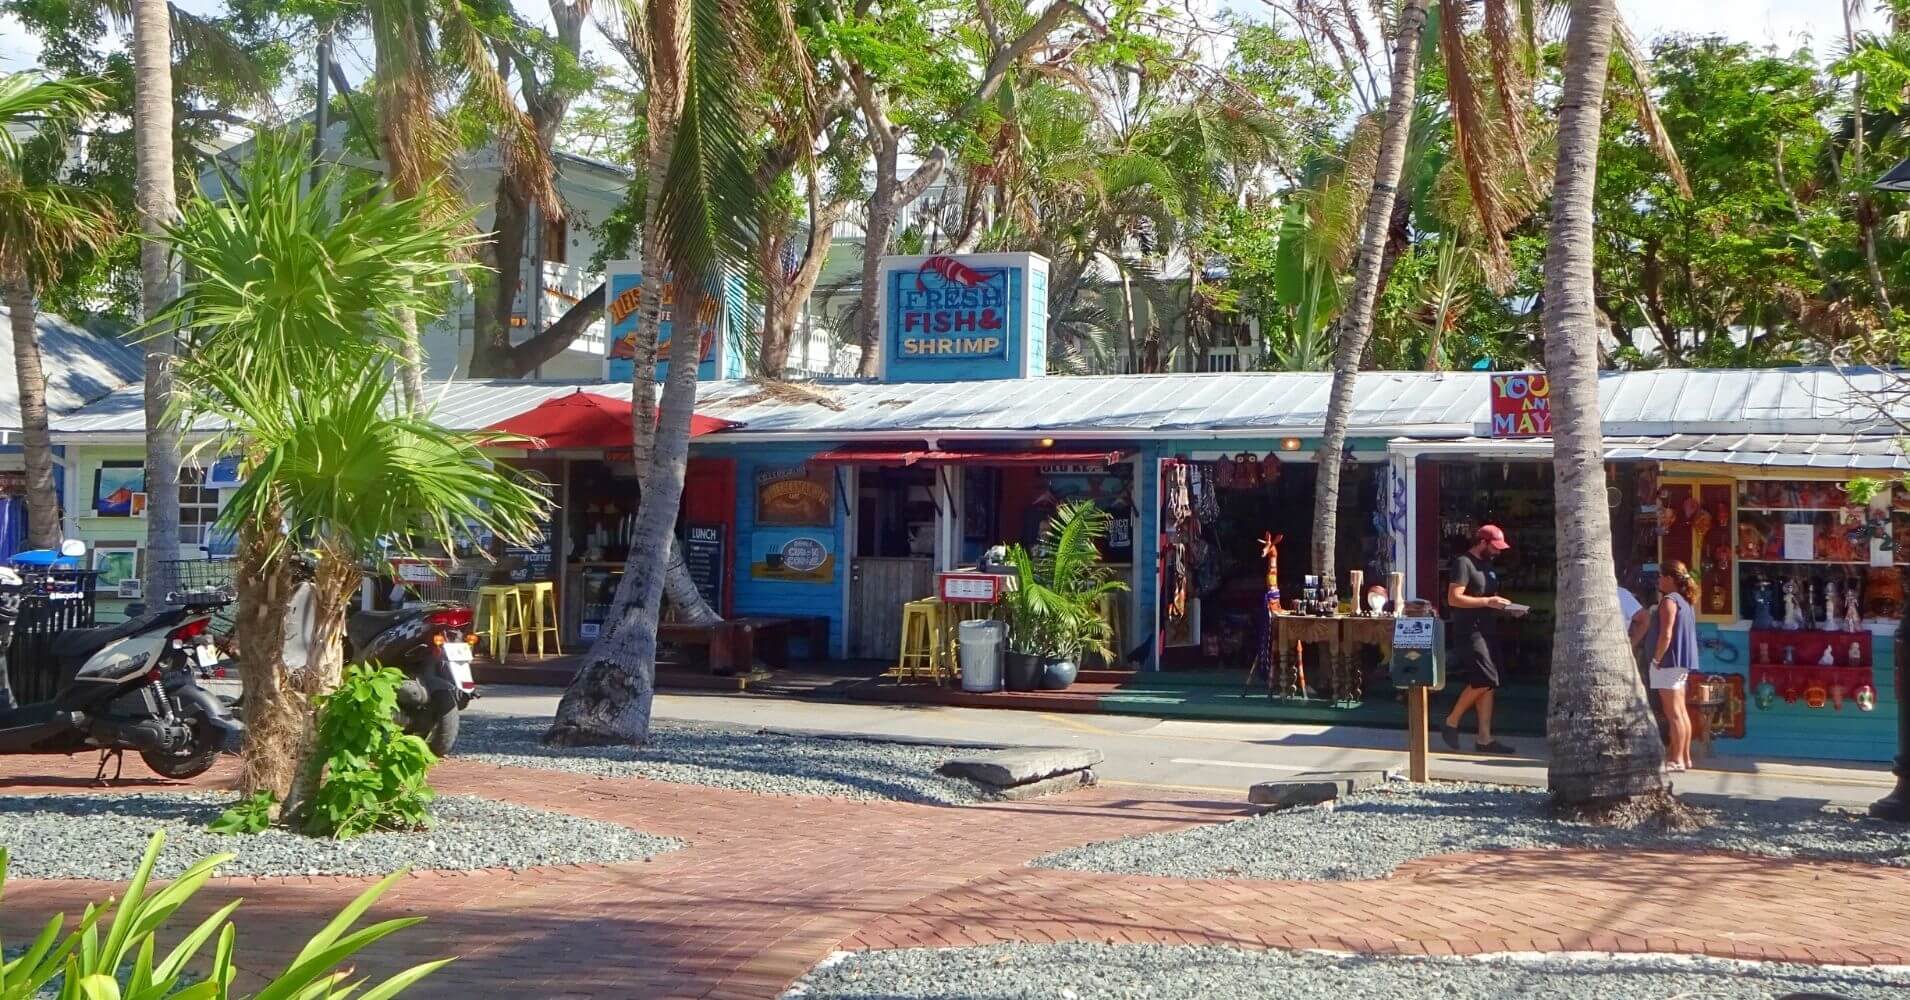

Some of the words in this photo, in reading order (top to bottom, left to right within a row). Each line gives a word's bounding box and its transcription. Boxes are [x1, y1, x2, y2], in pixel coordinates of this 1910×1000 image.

[905, 288, 1002, 310] FRESH
[903, 337, 1000, 355] SHRIMP
[1494, 412, 1551, 433] MAY
[692, 527, 717, 541] LUNCH
[530, 553, 552, 561] COFFEE
